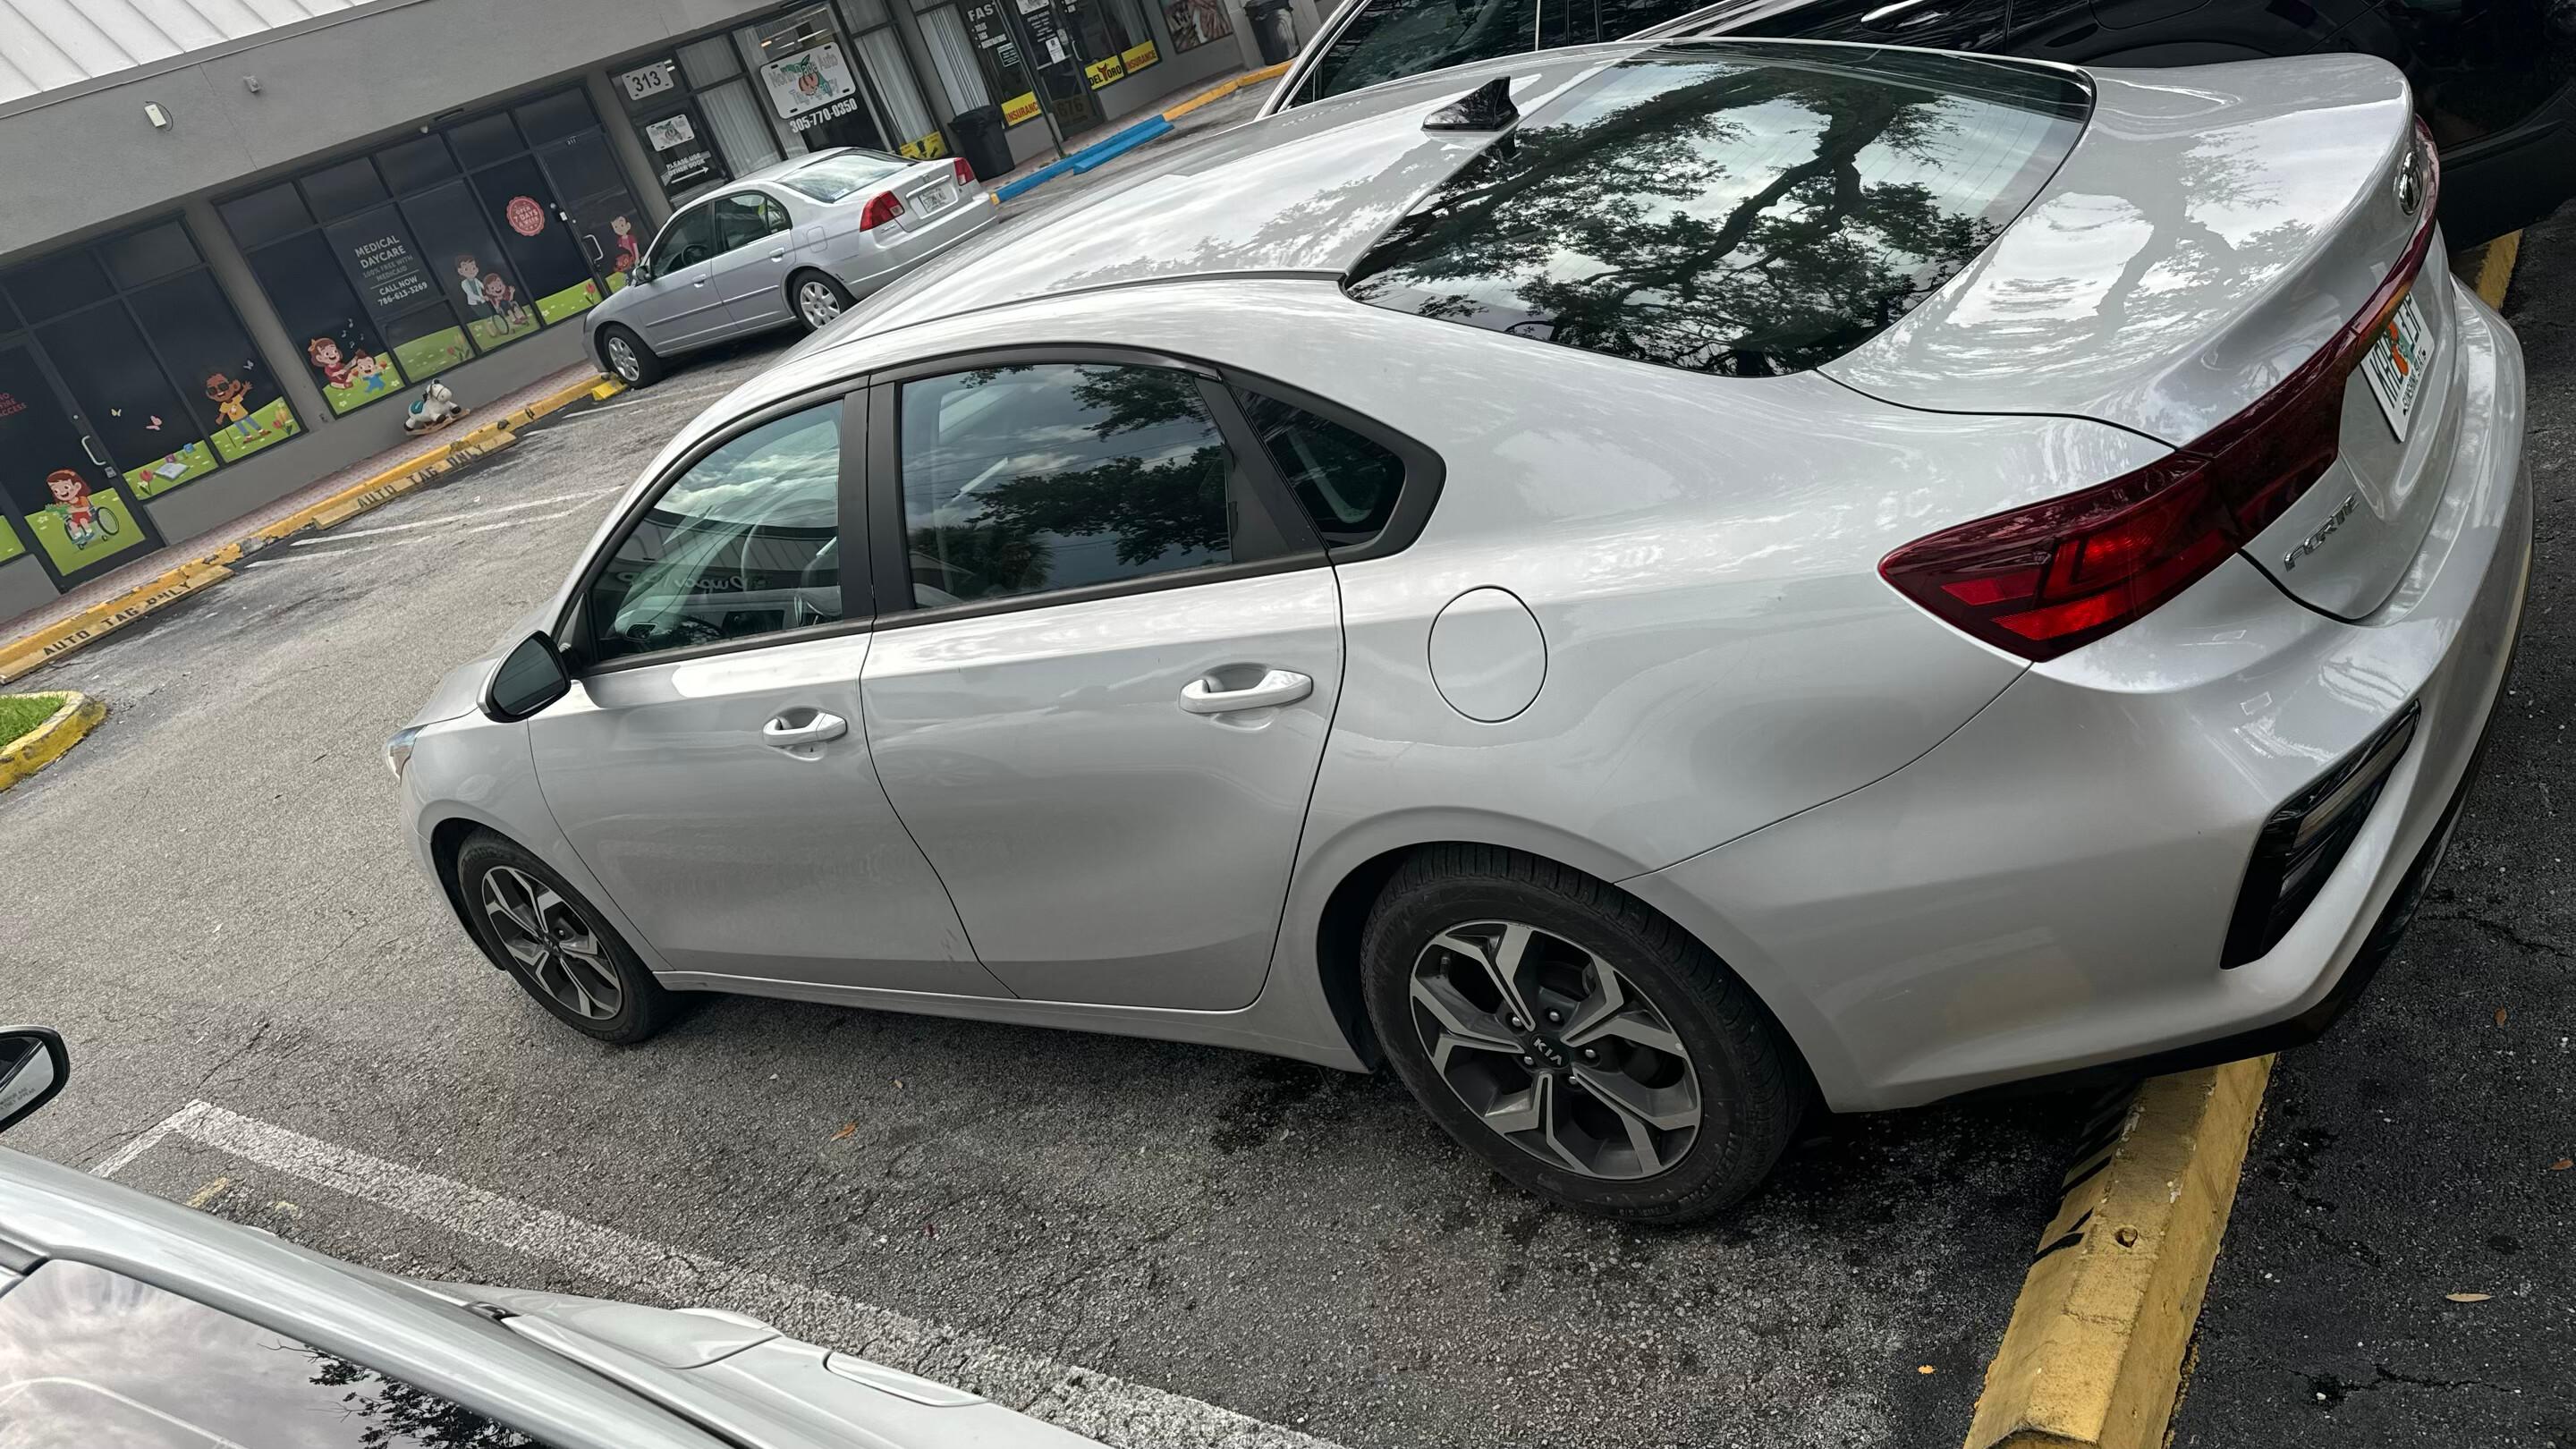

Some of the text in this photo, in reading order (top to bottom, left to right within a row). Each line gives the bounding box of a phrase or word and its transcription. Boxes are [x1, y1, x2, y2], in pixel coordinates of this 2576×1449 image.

[968, 1, 996, 21] FAS
[1125, 49, 1157, 71] INSURANCE
[631, 71, 662, 92] 313
[1089, 72, 1104, 87] DEL
[789, 97, 859, 133] 305-770-0350
[1006, 101, 1038, 123] INSURANC
[665, 157, 688, 170] PLEASE
[519, 208, 538, 221] DAYS
[354, 234, 400, 258] MEDICAL
[360, 245, 406, 269] DAYCARE
[377, 281, 428, 306] 786-613-3269
[378, 275, 418, 296] CALL NOW
[358, 445, 485, 508] AUTO TAG ONLY
[2284, 492, 2360, 572] FORTE
[43, 629, 91, 656] AUTO
[100, 606, 140, 627] TAG
[1533, 1038, 1562, 1066] KIA
